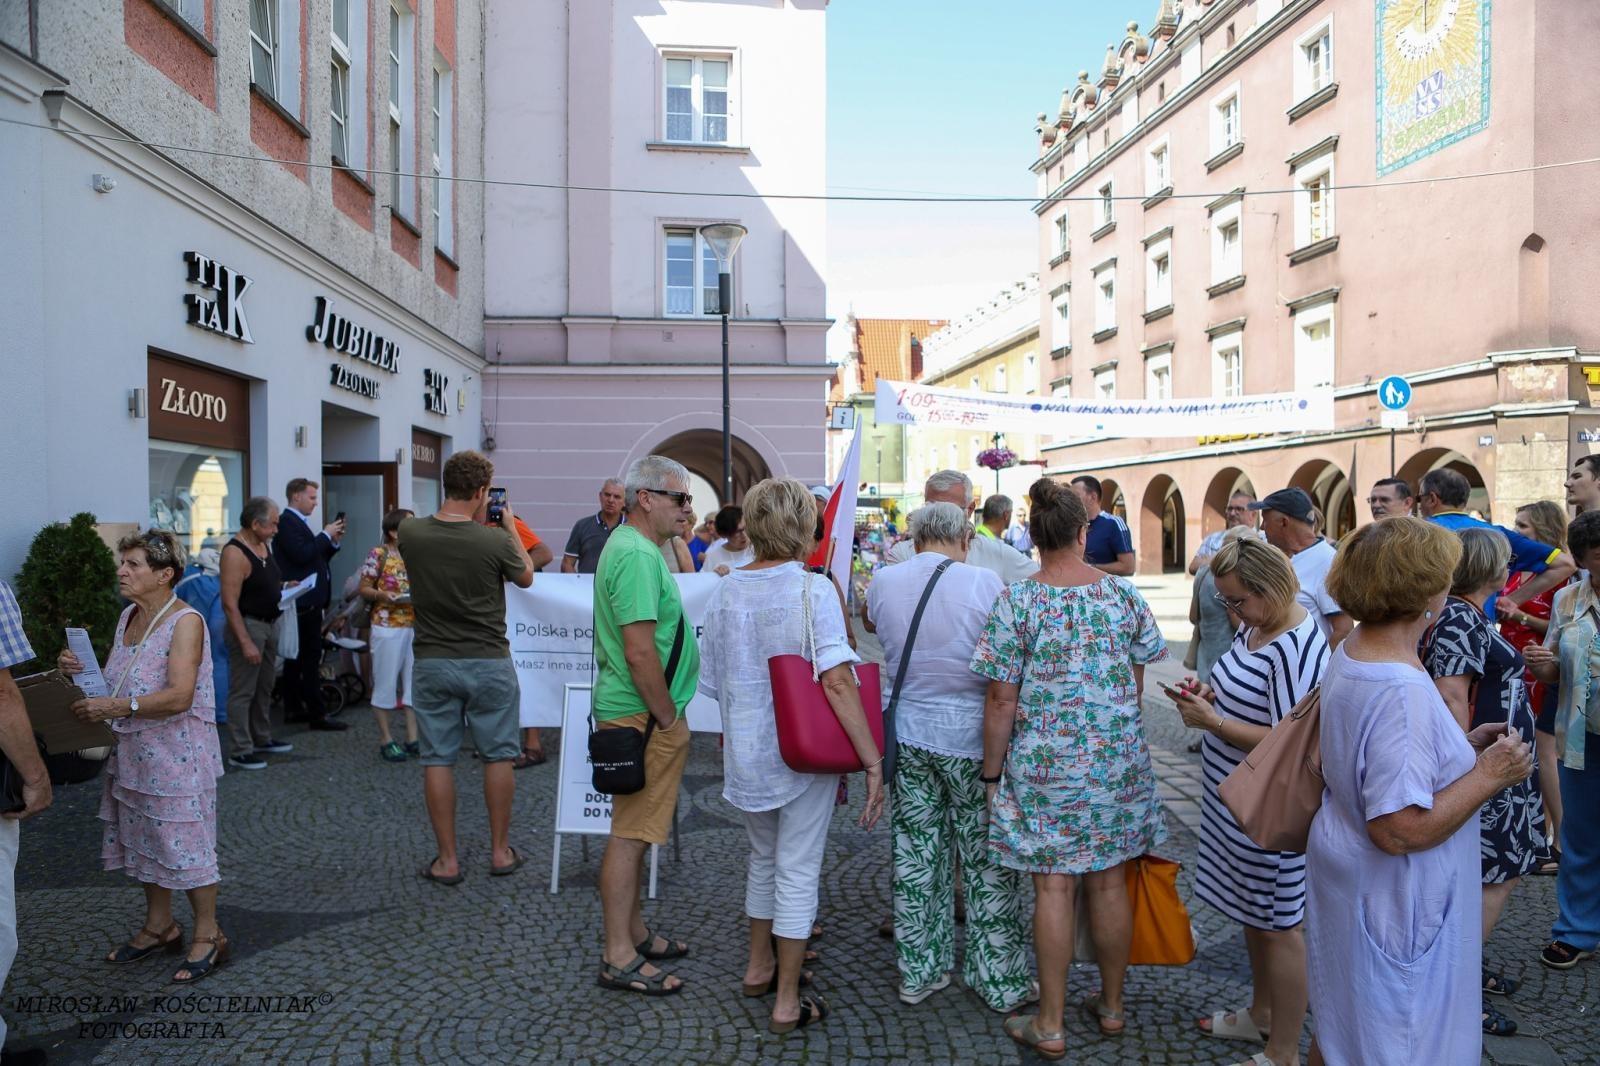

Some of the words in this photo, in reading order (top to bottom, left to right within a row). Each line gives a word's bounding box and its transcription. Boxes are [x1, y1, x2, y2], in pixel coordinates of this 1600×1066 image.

[309, 297, 401, 374] JUBILER
[161, 378, 227, 423] ZŁOTO
[412, 443, 435, 464] REBRO
[515, 623, 568, 638] Polska
[574, 627, 593, 641] po
[515, 660, 545, 670] Masz
[548, 660, 573, 671] inne
[576, 660, 596, 671] zda
[585, 793, 612, 803] DOŁ
[583, 807, 601, 817] DO
